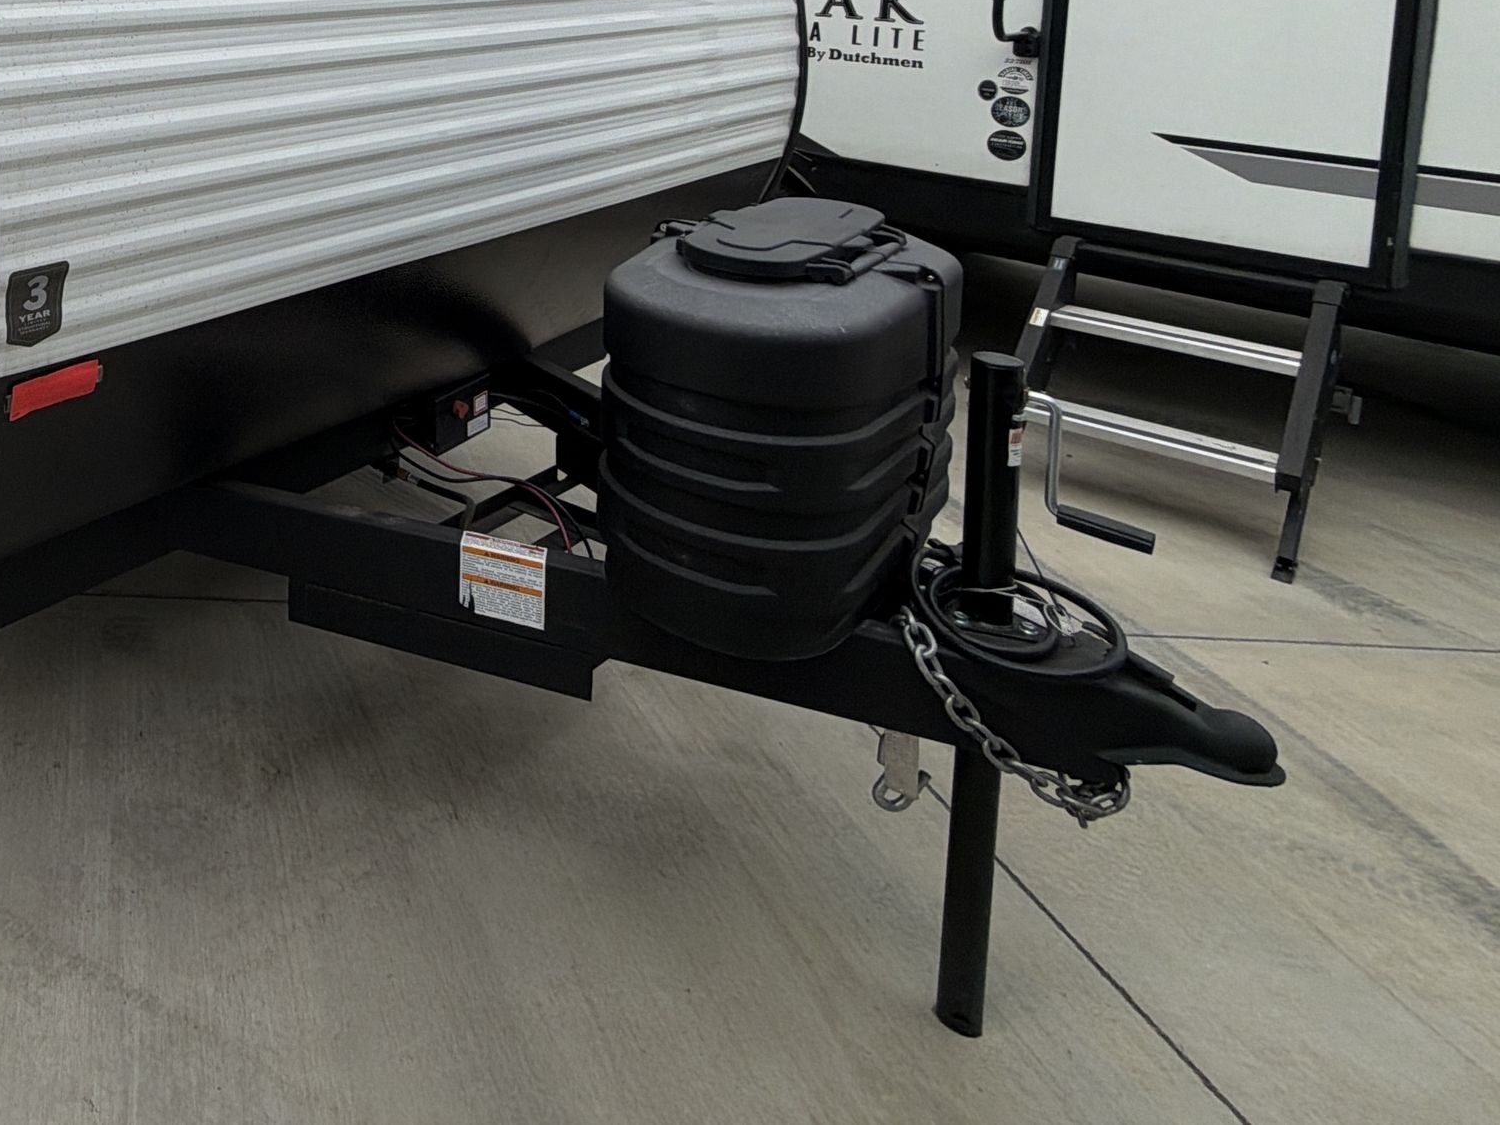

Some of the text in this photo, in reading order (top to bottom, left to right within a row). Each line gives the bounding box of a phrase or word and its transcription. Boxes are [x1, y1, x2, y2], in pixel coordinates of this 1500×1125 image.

[851, 24, 926, 51] LITE
[806, 46, 924, 69] By Dutchmen
[23, 275, 49, 311] 3
[18, 309, 51, 323] YEAR
